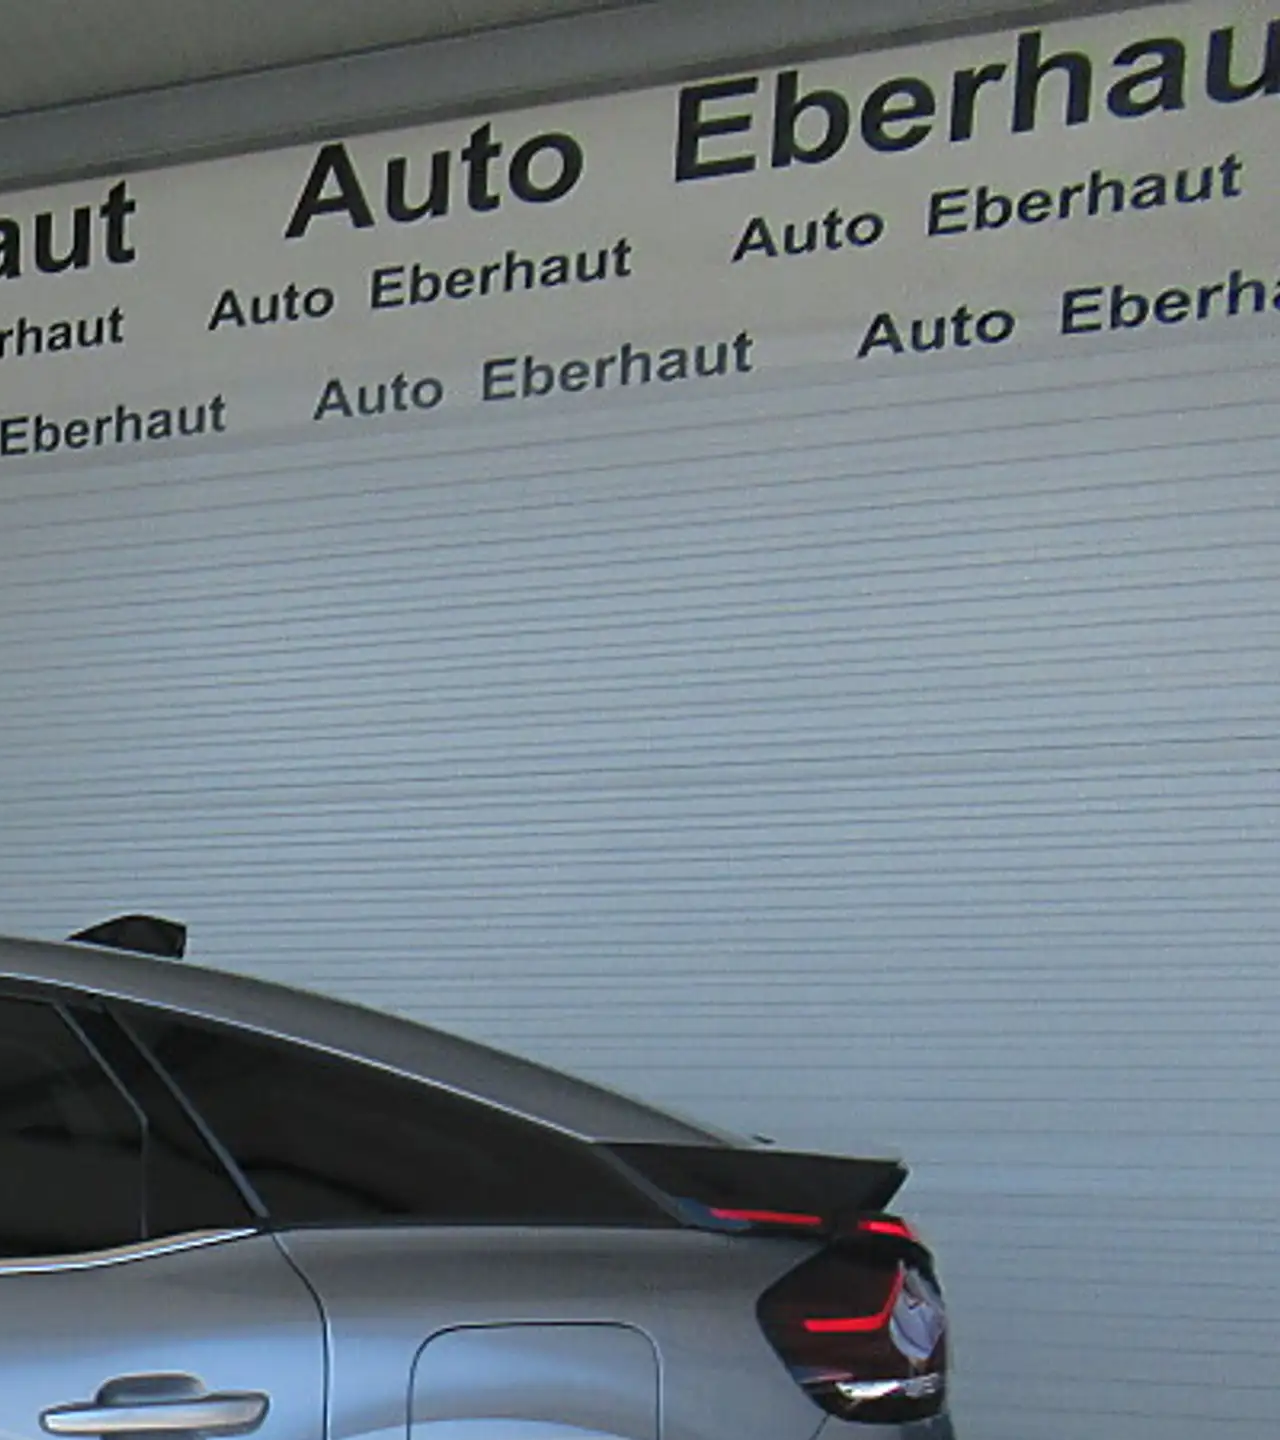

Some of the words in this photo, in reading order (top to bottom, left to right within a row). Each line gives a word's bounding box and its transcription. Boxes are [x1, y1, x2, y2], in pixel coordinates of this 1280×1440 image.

[284, 122, 583, 240] Auto
[731, 208, 884, 263] Auto
[928, 154, 1242, 237] Eberhaut
[208, 282, 334, 331] Auto
[371, 238, 631, 310] Eberhaut
[313, 372, 443, 420] Auto
[483, 330, 753, 401] Eberhaut
[857, 304, 1015, 359] Auto
[0, 394, 226, 456] Eberhaut
